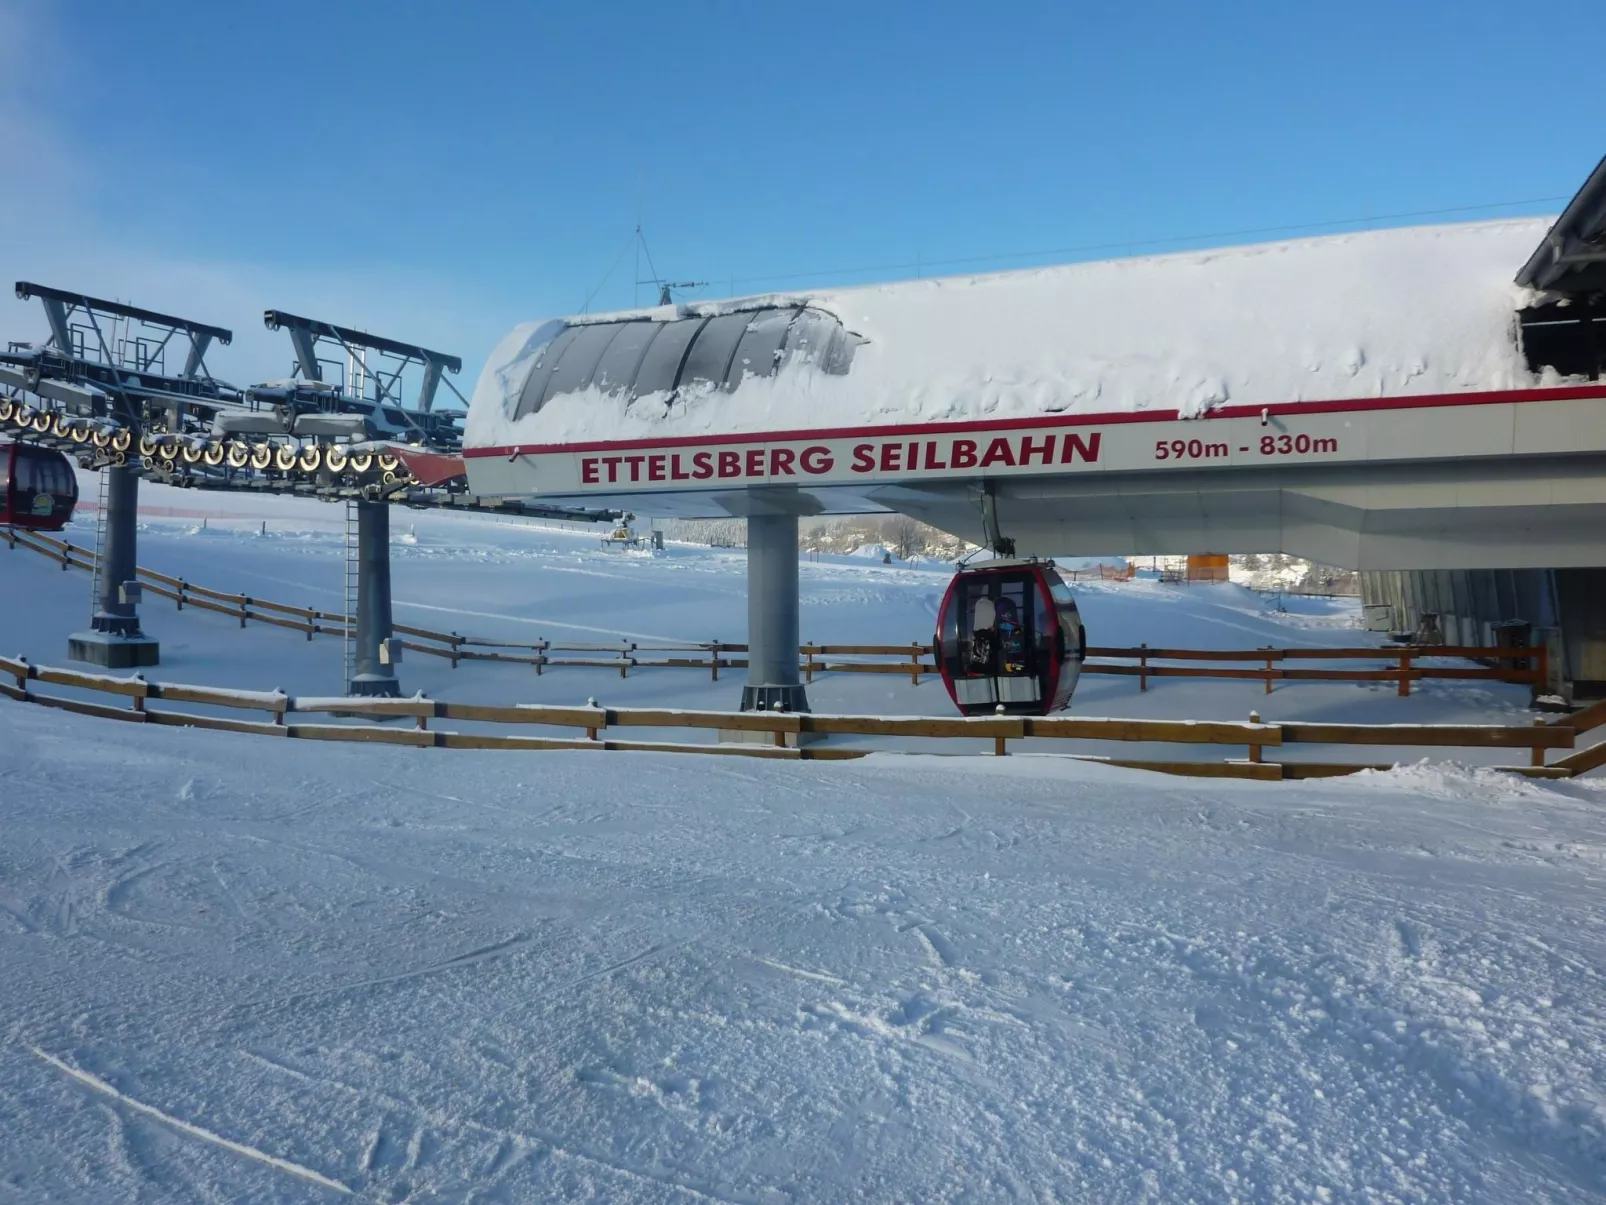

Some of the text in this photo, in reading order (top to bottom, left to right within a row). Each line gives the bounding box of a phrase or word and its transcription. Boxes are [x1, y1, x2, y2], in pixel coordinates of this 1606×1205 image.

[581, 432, 1101, 484] ETTELSBERG SEILBAHN
[1155, 439, 1228, 460] 590m
[1260, 434, 1337, 456] 830m
